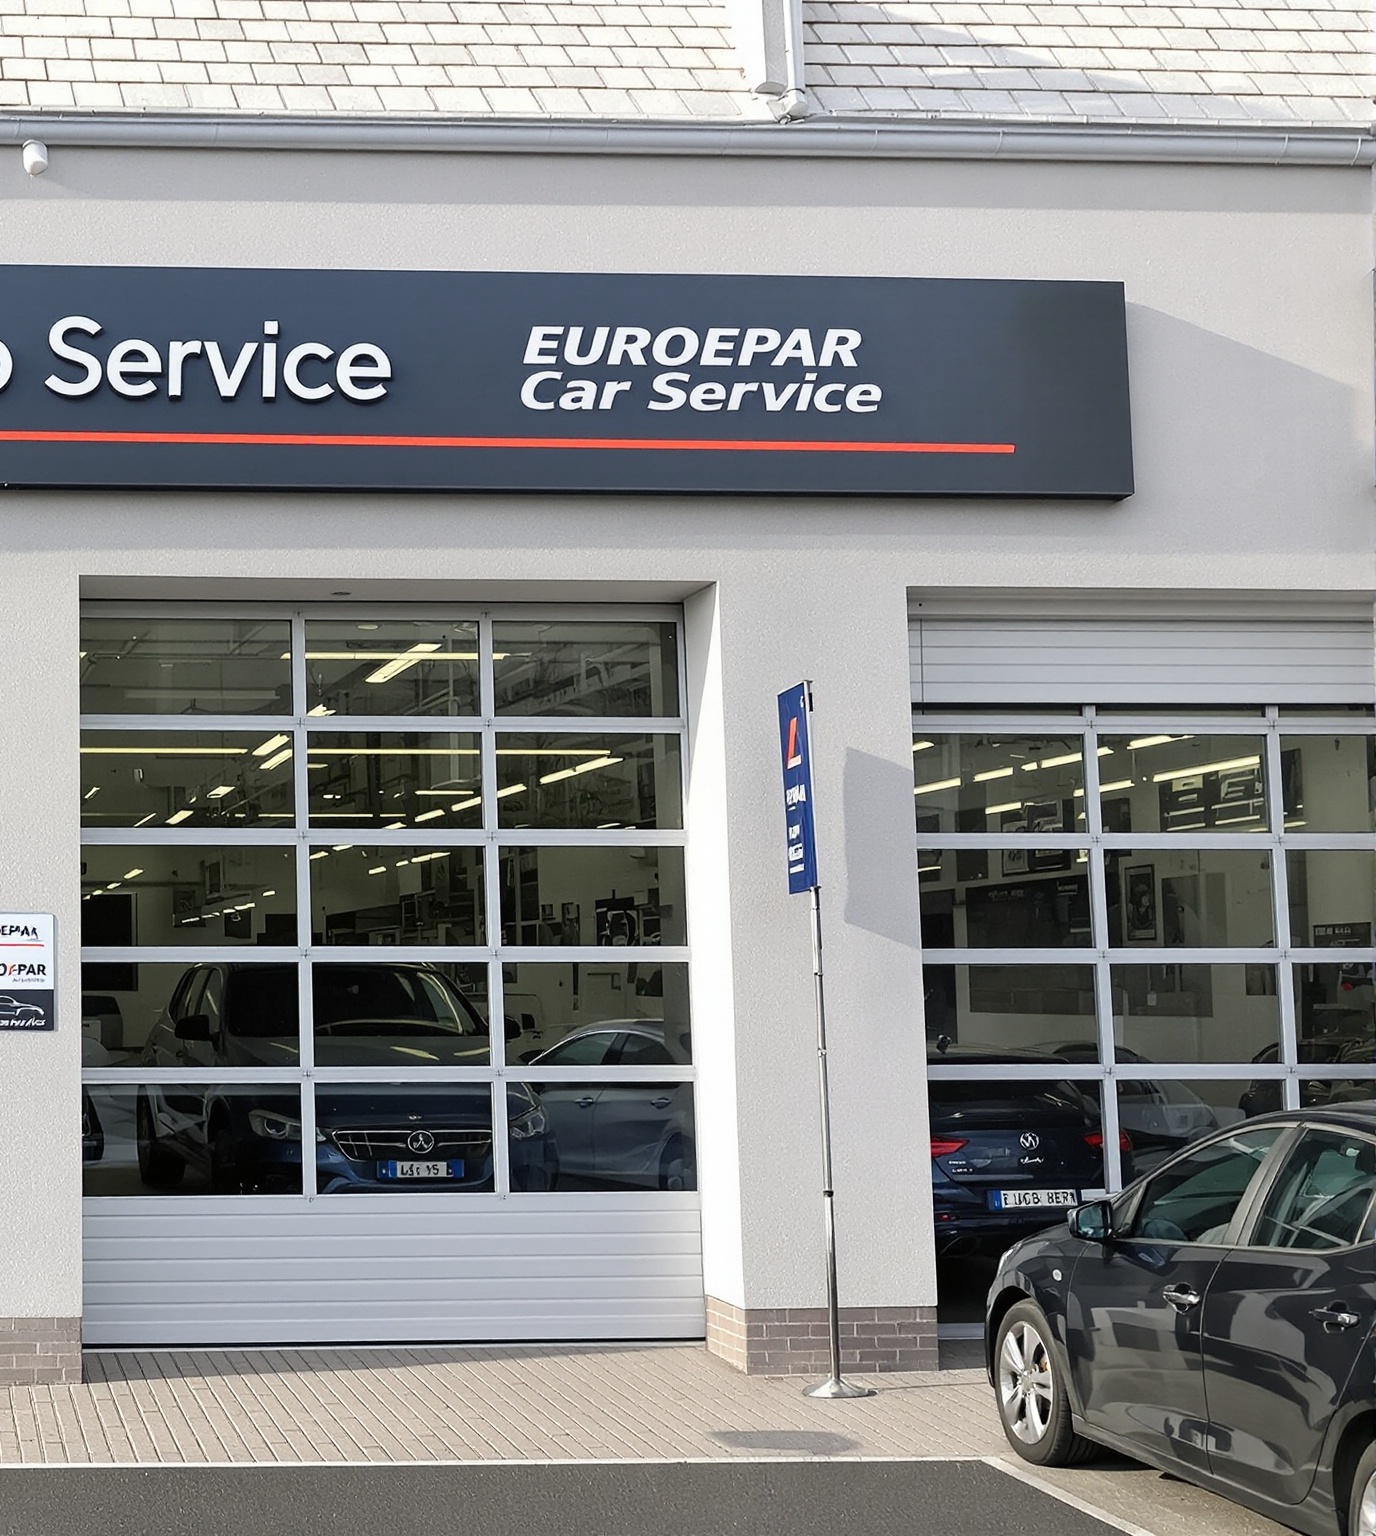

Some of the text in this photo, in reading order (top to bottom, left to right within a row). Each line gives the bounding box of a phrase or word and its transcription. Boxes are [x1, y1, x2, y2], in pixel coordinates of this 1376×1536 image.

[44, 315, 393, 401] Service
[522, 325, 863, 367] EUROEPAR
[520, 370, 883, 413] Car Service
